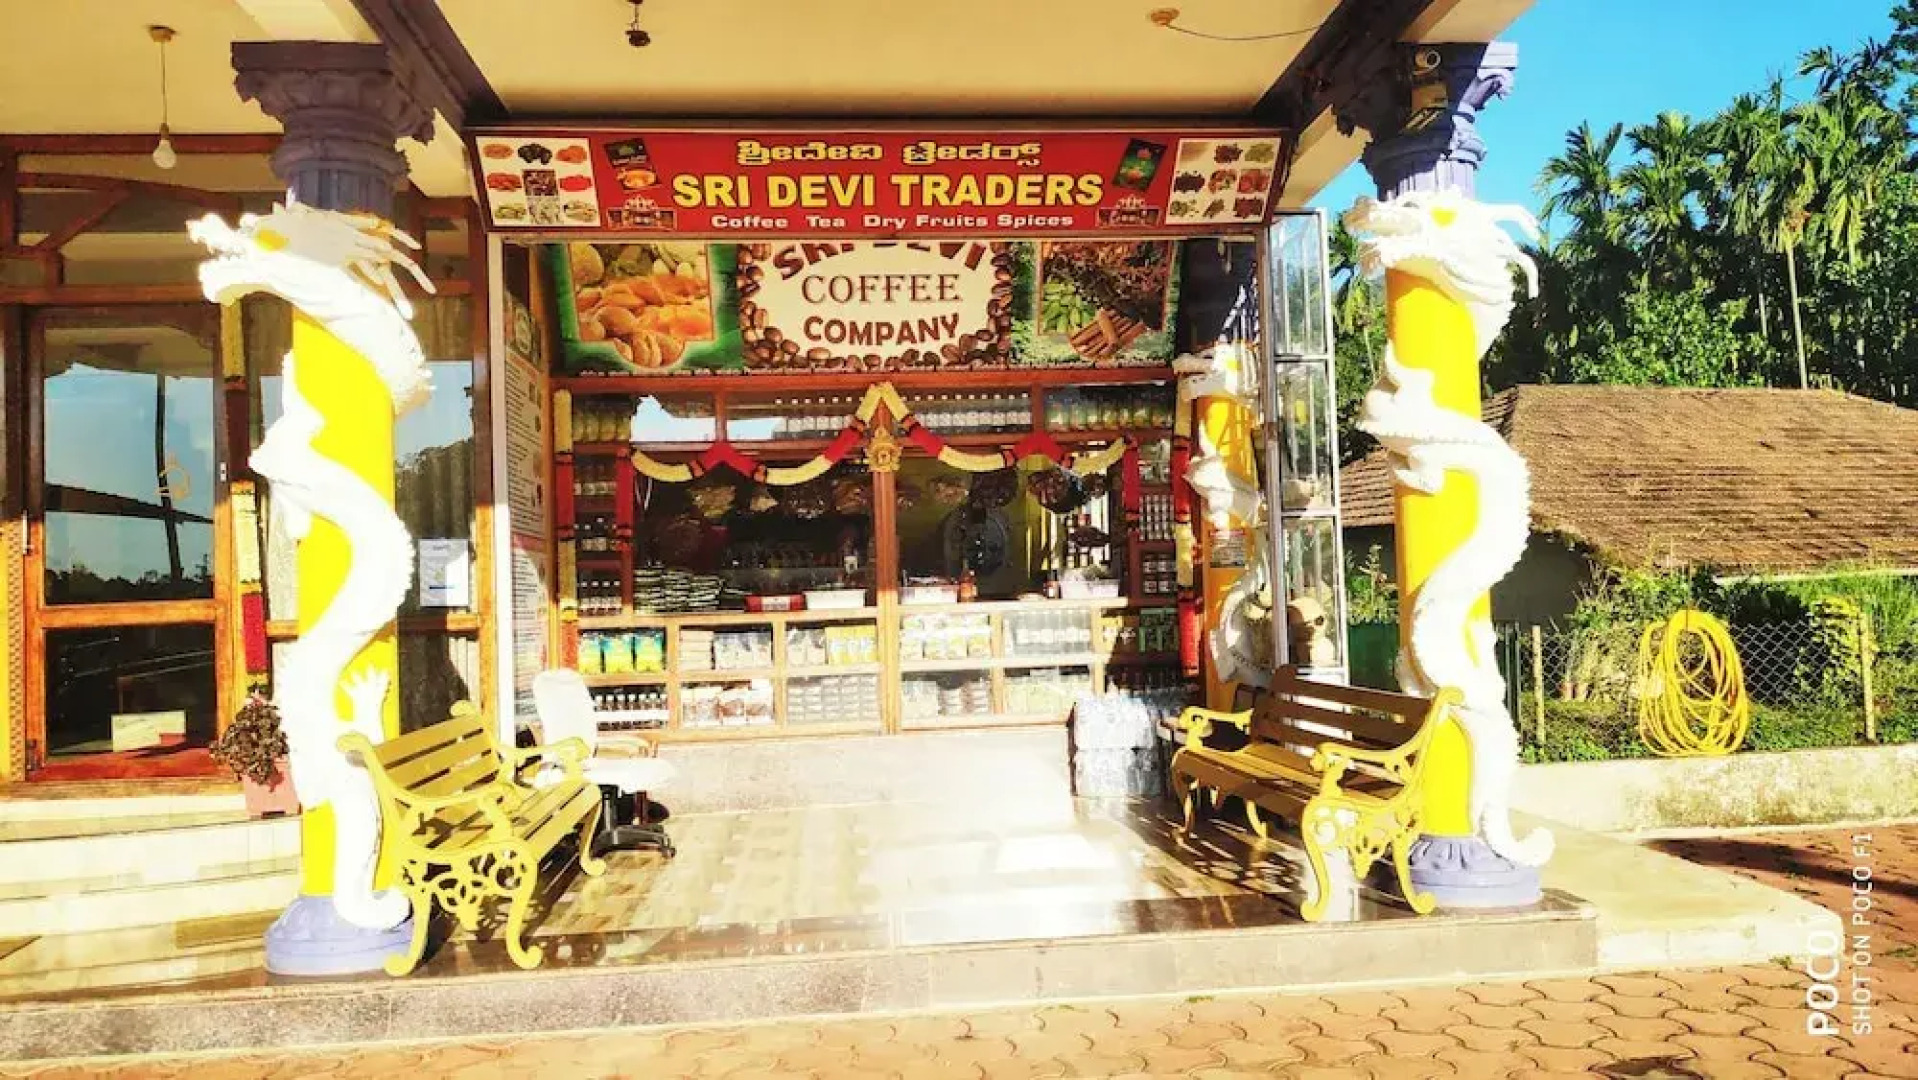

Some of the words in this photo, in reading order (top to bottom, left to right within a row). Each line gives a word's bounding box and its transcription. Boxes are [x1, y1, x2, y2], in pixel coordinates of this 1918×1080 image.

[672, 174, 750, 208] SRI
[767, 174, 875, 208] DEVI
[891, 174, 1104, 208] TRADERS
[711, 213, 789, 229] Coffee
[805, 213, 847, 229] Tea
[864, 213, 907, 231] Dry
[916, 213, 989, 228] Fruits
[997, 213, 1074, 230] Spices
[801, 274, 963, 304] COFFEE
[803, 312, 960, 346] COMPANY
